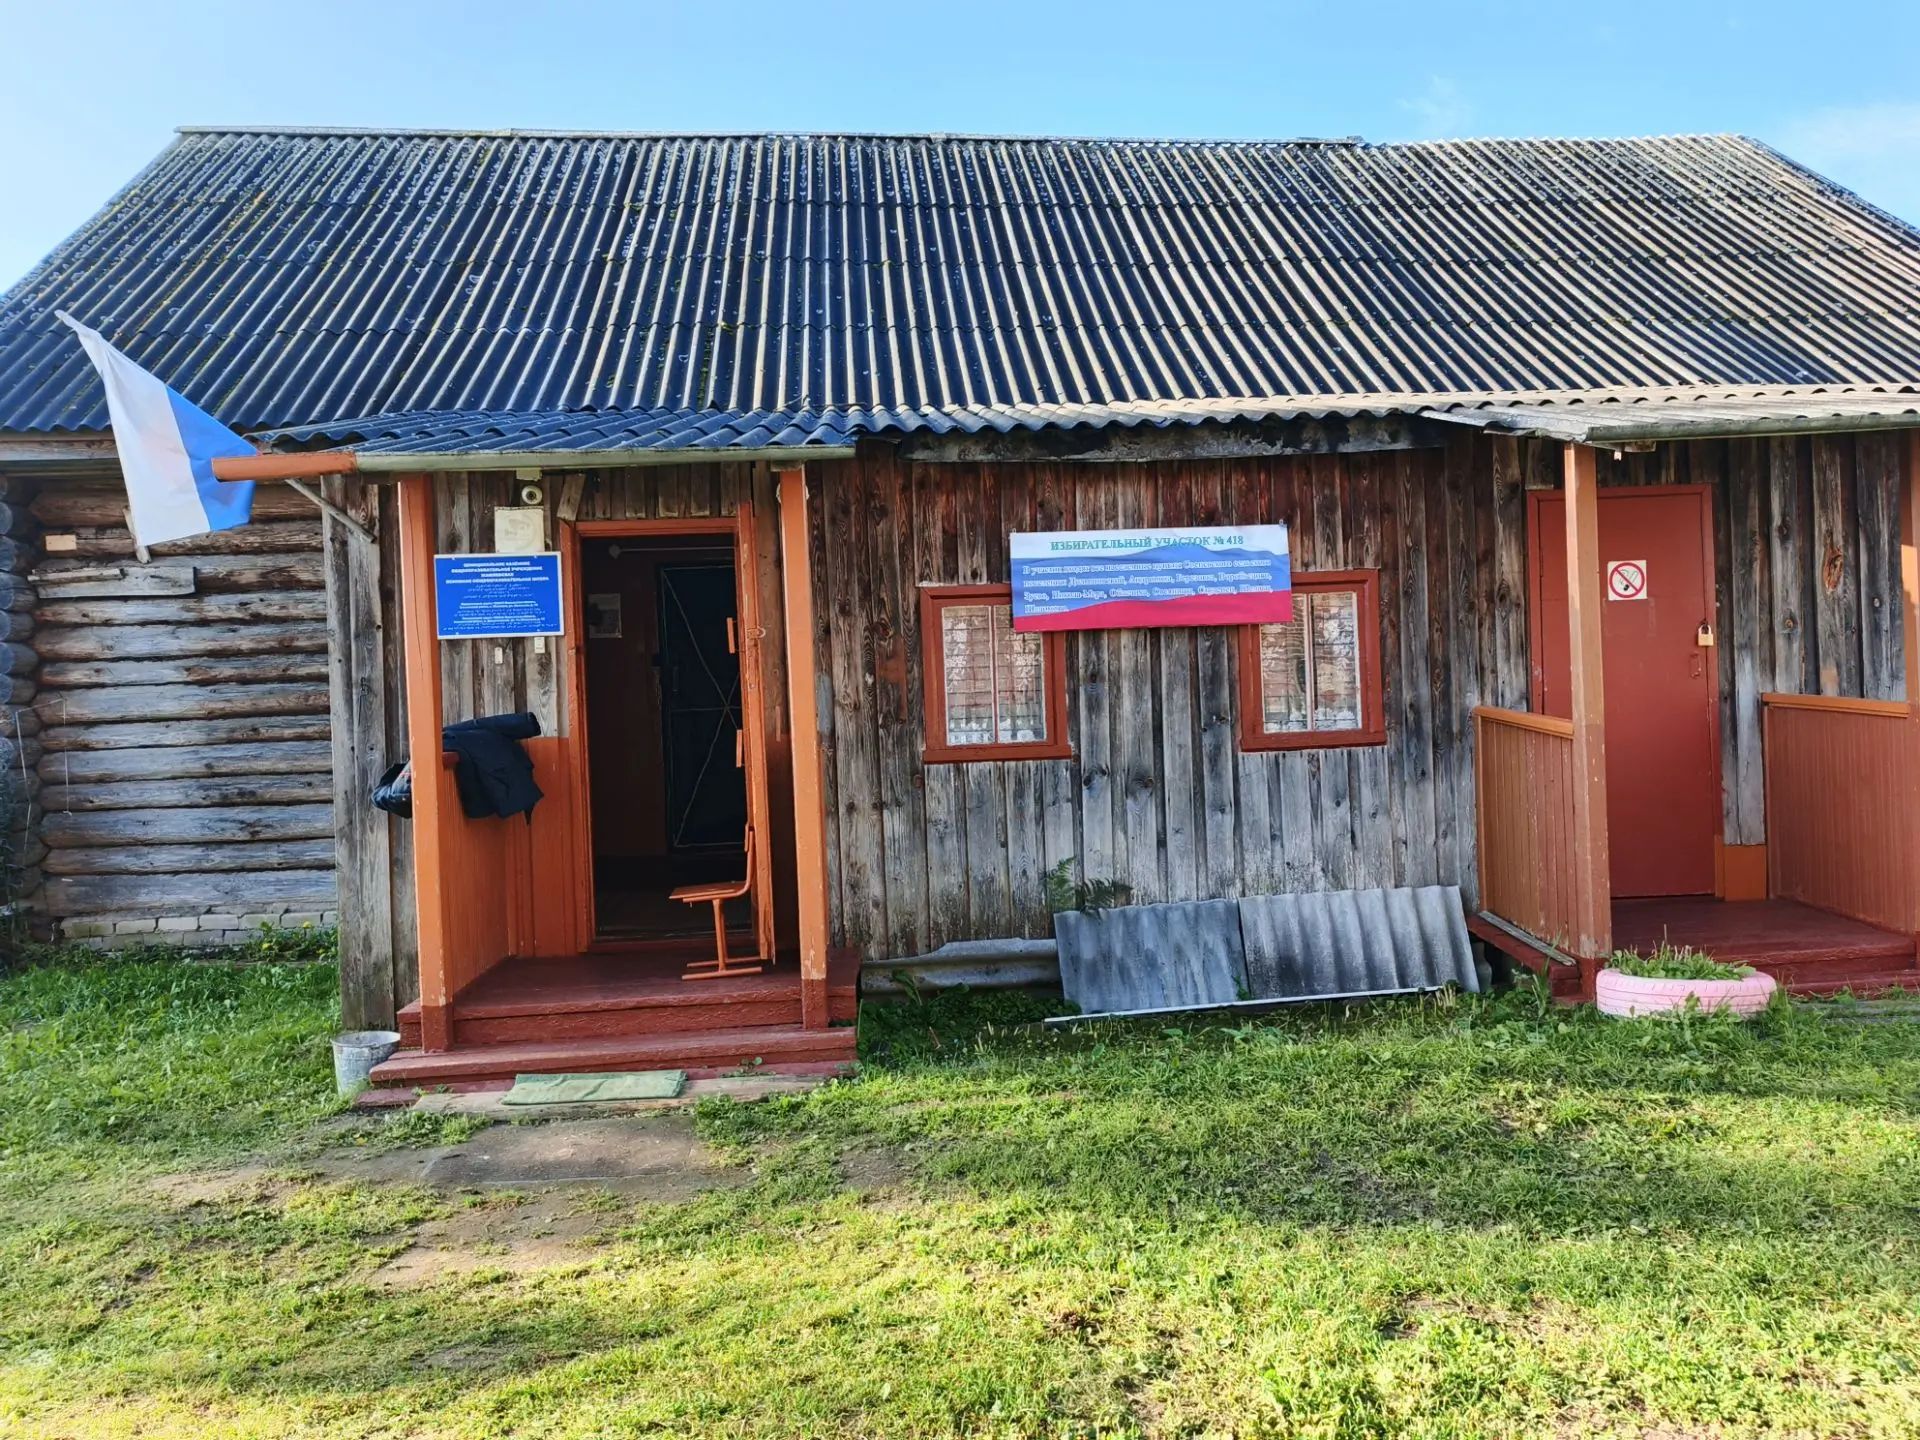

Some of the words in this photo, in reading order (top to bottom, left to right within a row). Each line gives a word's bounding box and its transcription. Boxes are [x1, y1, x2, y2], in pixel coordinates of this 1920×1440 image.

[1050, 536, 1152, 551] ИЗБИРАТЕЛЬНЫЙ
[1155, 536, 1212, 547] УЧАСТОК
[1213, 535, 1224, 545] №
[1226, 535, 1244, 545] 418
